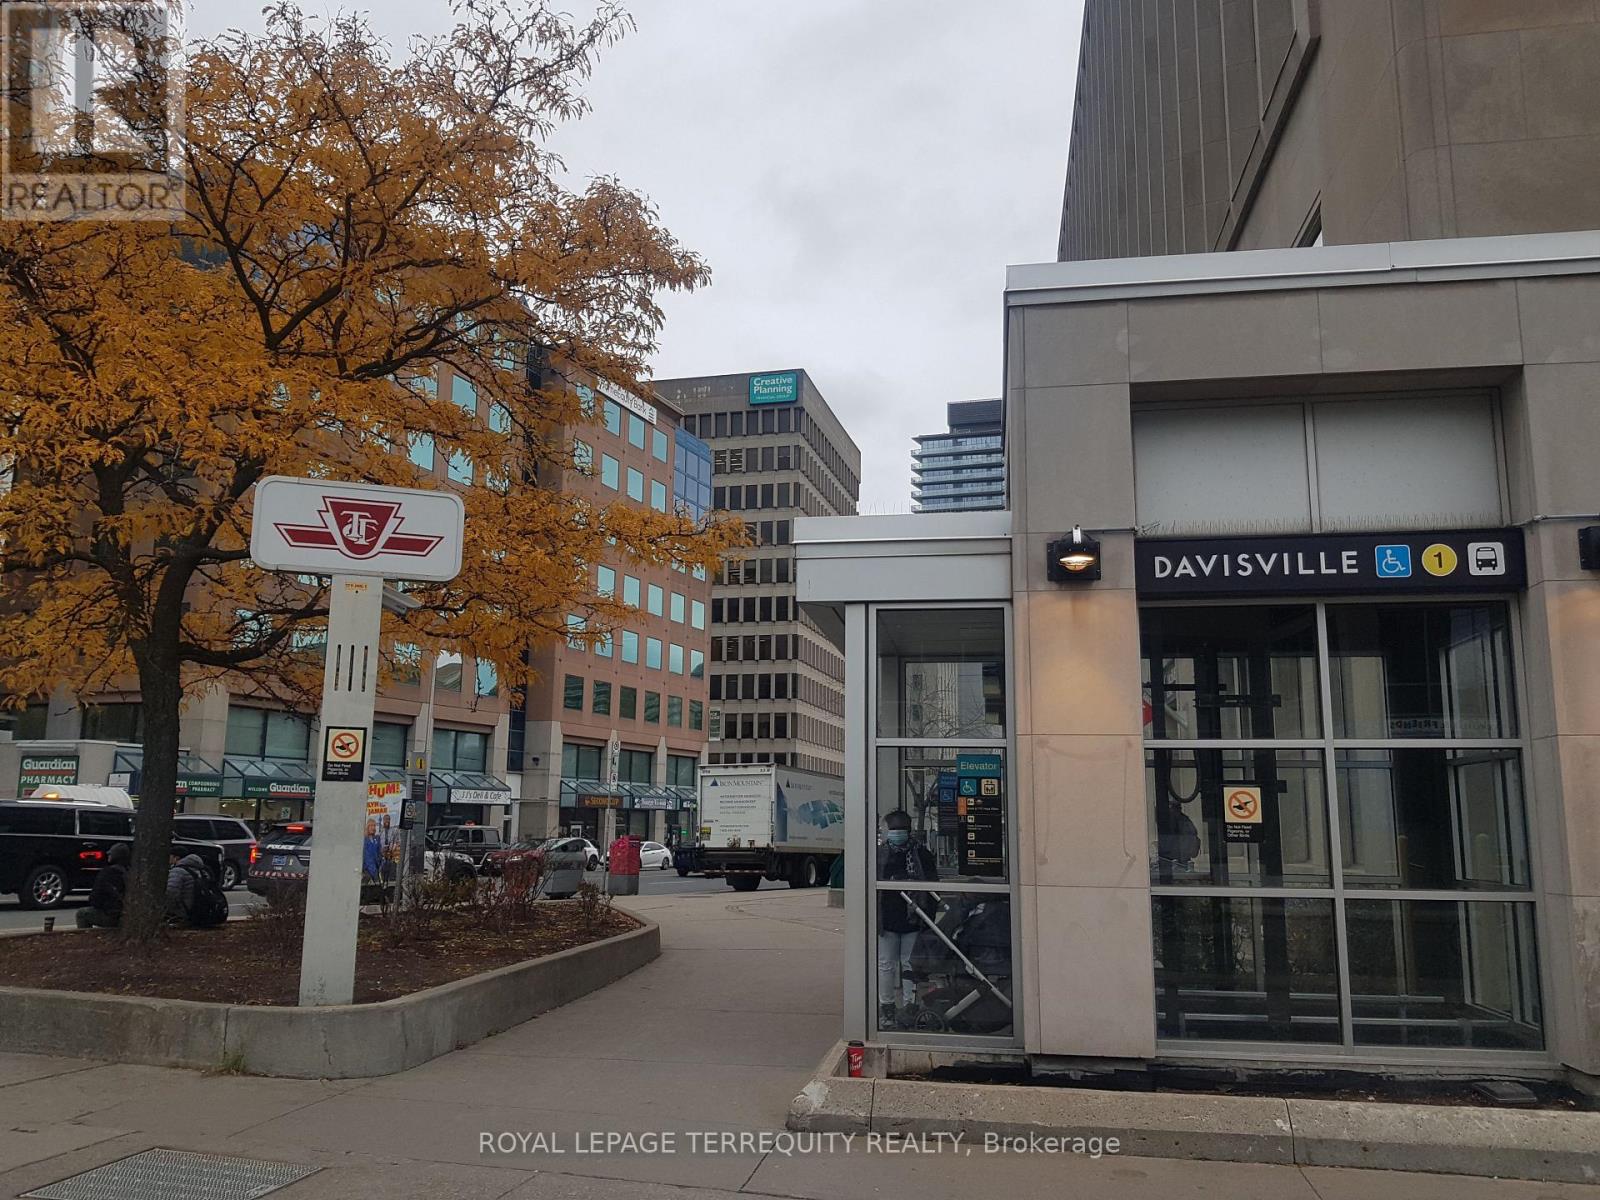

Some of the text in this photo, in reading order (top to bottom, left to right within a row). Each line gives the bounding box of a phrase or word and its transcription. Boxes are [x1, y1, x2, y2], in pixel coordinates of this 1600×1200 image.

[753, 377, 793, 386] Creative
[753, 385, 793, 395] Planning
[1153, 551, 1443, 579] DAVISVILLE 1
[22, 758, 76, 770] Guardian
[960, 761, 996, 770] Elevator
[20, 775, 76, 784] PHARMACY
[269, 782, 311, 793] Guardian
